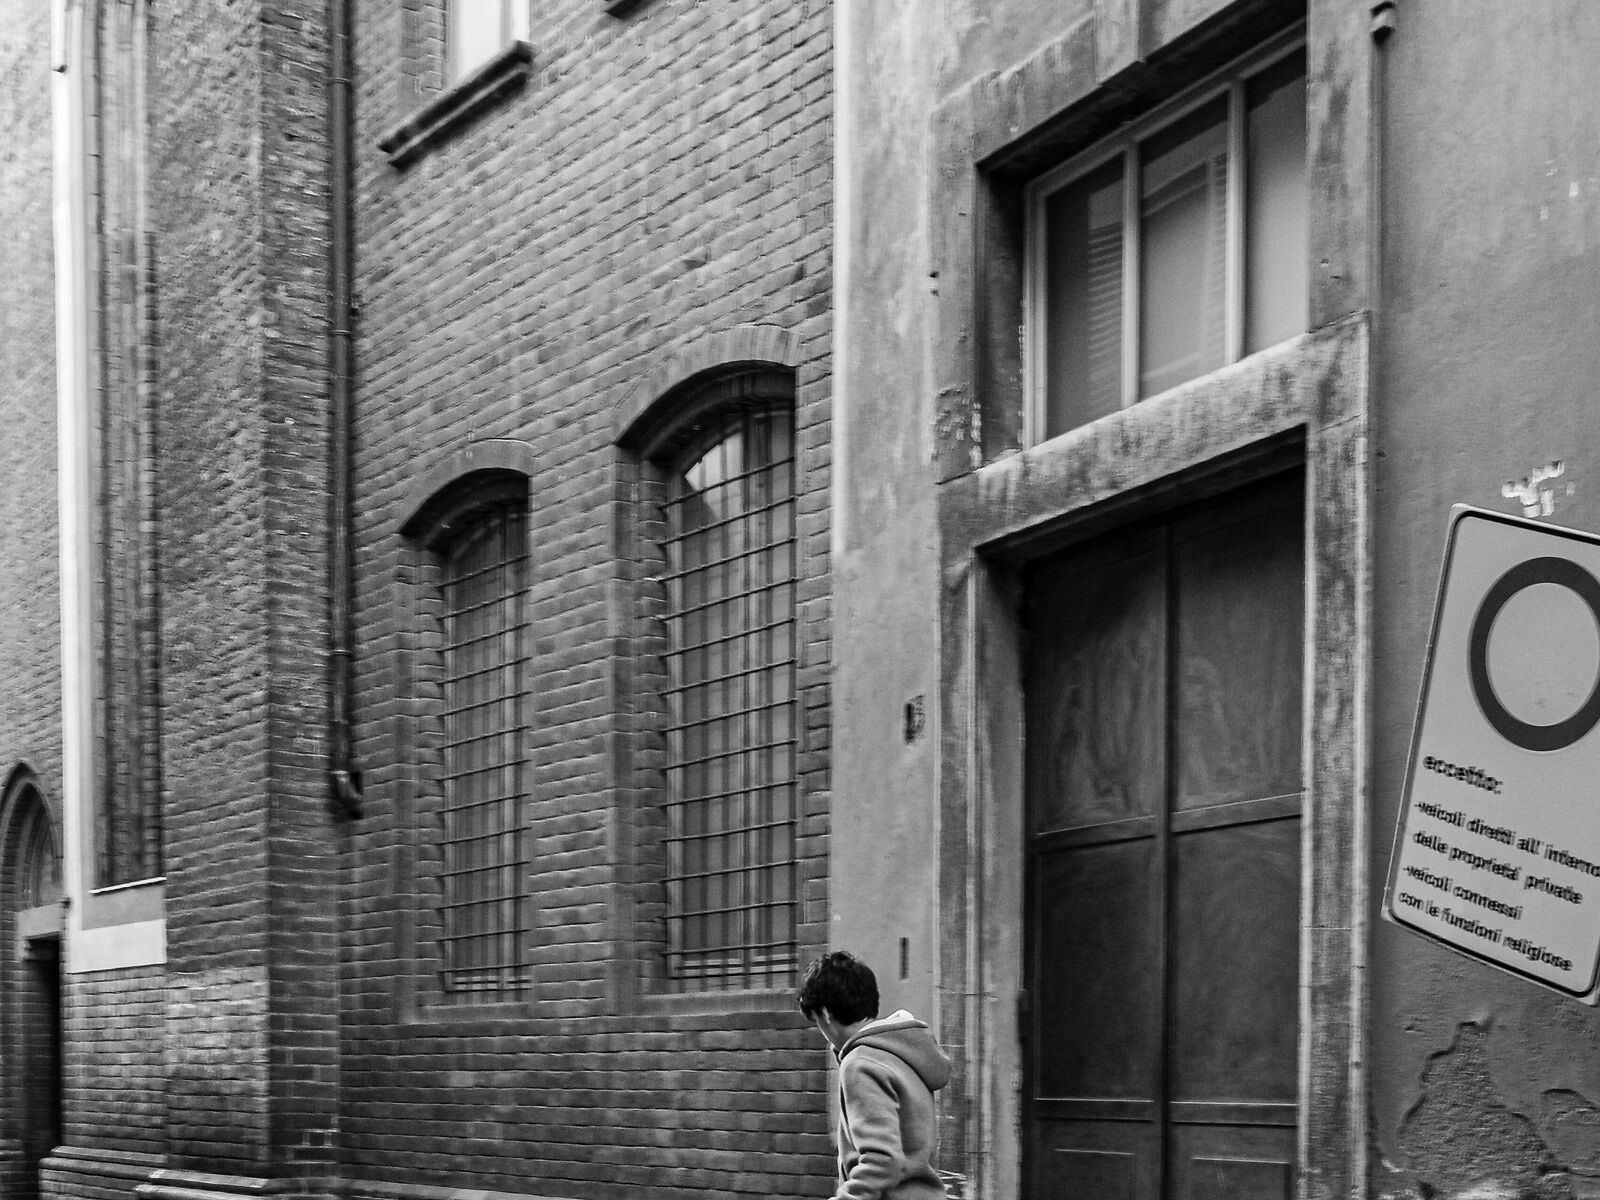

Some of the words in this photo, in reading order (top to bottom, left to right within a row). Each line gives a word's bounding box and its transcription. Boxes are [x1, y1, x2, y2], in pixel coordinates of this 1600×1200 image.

[1414, 801, 1466, 827] -veicoli
[1466, 819, 1515, 845] diretti
[1403, 865, 1452, 892] -veicoli
[1453, 885, 1523, 919] connessi
[1413, 831, 1448, 853] delle
[1524, 875, 1583, 904] private
[1399, 892, 1423, 910] con
[1426, 900, 1440, 917] le
[1441, 908, 1502, 942] funzioni
[1503, 936, 1572, 971] religiose
